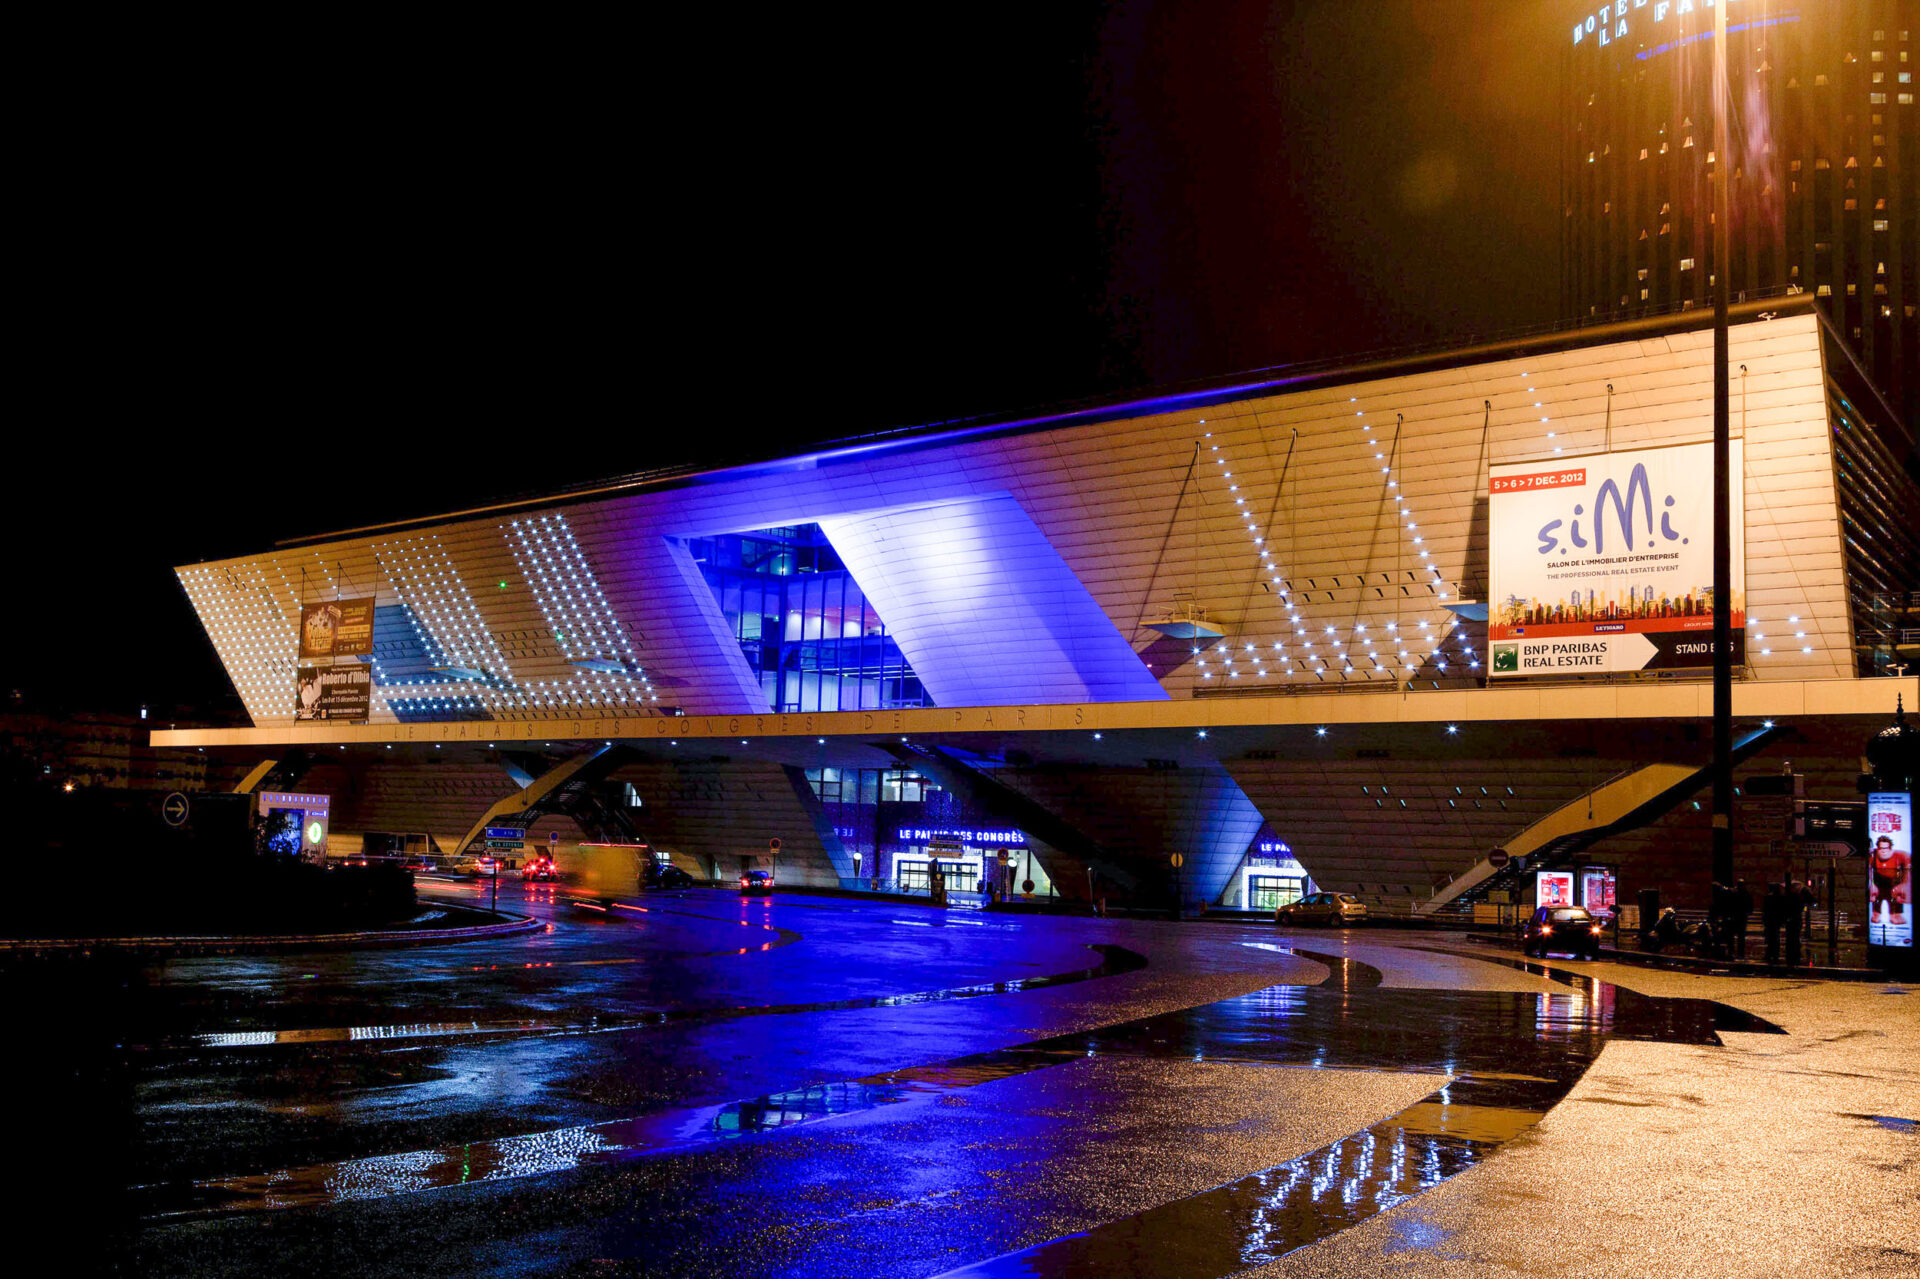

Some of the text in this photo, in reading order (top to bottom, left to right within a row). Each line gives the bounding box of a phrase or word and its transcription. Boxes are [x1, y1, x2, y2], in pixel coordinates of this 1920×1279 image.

[1600, 18, 1628, 47] LA
[1494, 481, 1500, 489] 5
[1510, 479, 1517, 488] 6
[1527, 478, 1533, 486] 7
[1536, 476, 1558, 486] DEC.
[1560, 473, 1583, 483] 2012
[1581, 557, 1627, 566] L'IMMOBILIER
[1629, 553, 1679, 562] D'ENTREPRISE
[1560, 570, 1609, 579] PROFESSIONAL
[1656, 564, 1679, 572] EVENT
[1524, 642, 1607, 656] BNP PARIBAS
[1676, 643, 1707, 654] STAND
[1524, 655, 1603, 667] REAL ESTATE
[395, 726, 414, 739] LE
[443, 723, 532, 738] PALAIS
[573, 720, 621, 735] DES
[863, 713, 900, 730] DE
[954, 708, 1083, 728] PARIS
[900, 830, 911, 839] LE
[976, 830, 1024, 843] CONGRÈS
[1261, 843, 1271, 851] LE
